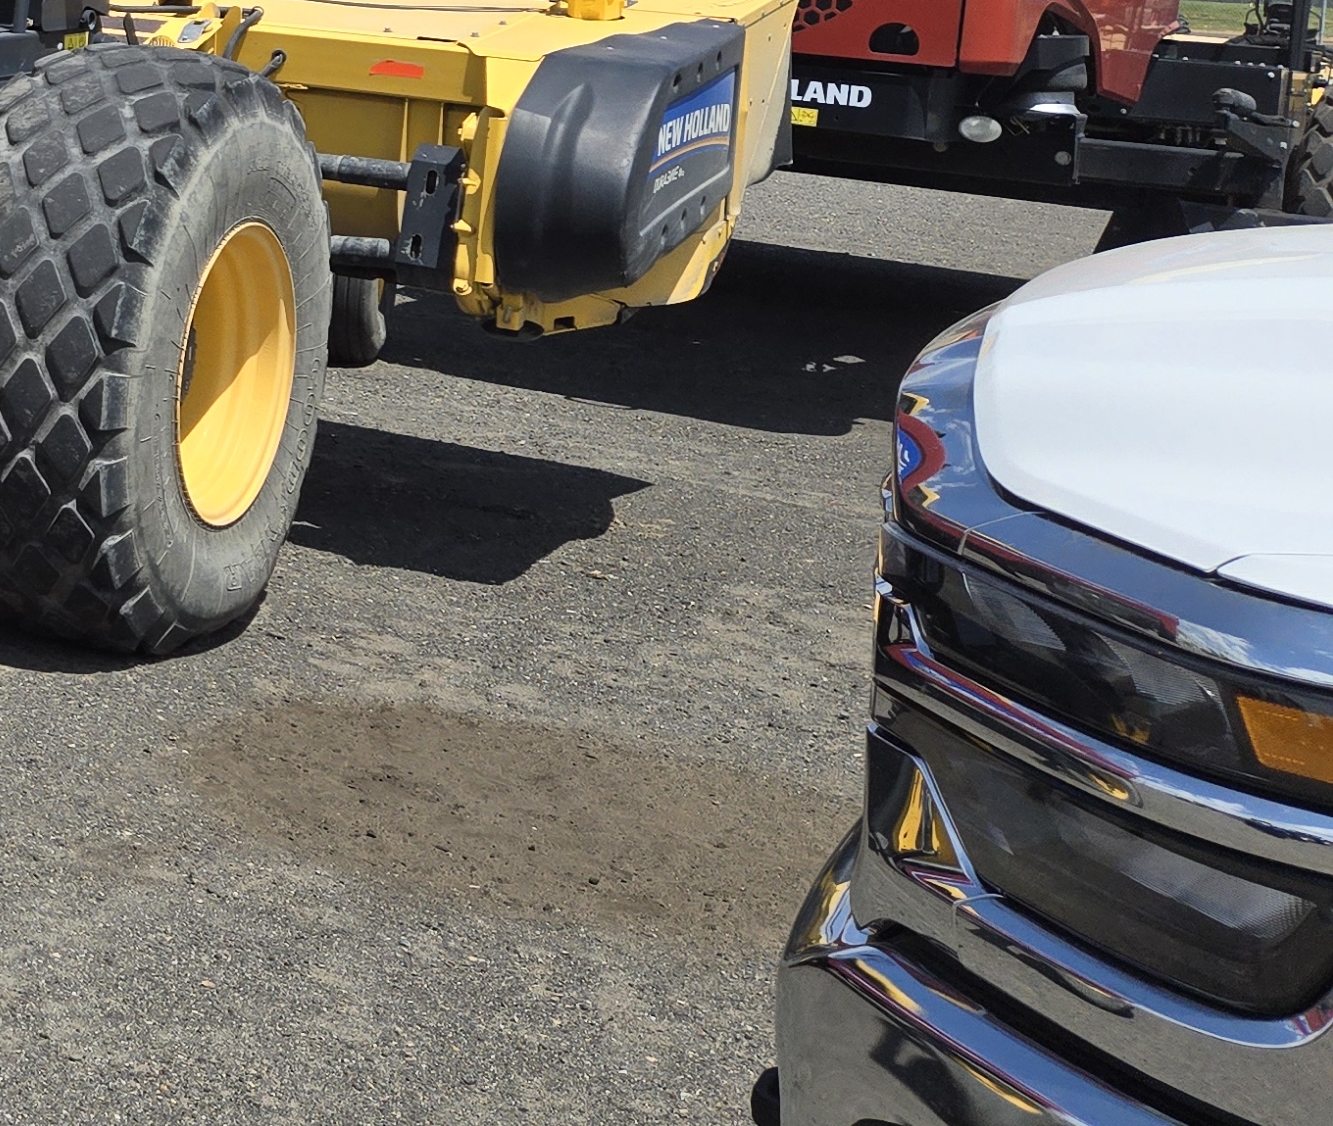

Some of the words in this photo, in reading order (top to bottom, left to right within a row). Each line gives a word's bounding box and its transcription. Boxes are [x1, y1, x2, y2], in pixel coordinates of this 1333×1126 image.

[790, 78, 873, 109] LAND
[657, 115, 686, 157] NEW
[683, 103, 731, 143] HOLLAND
